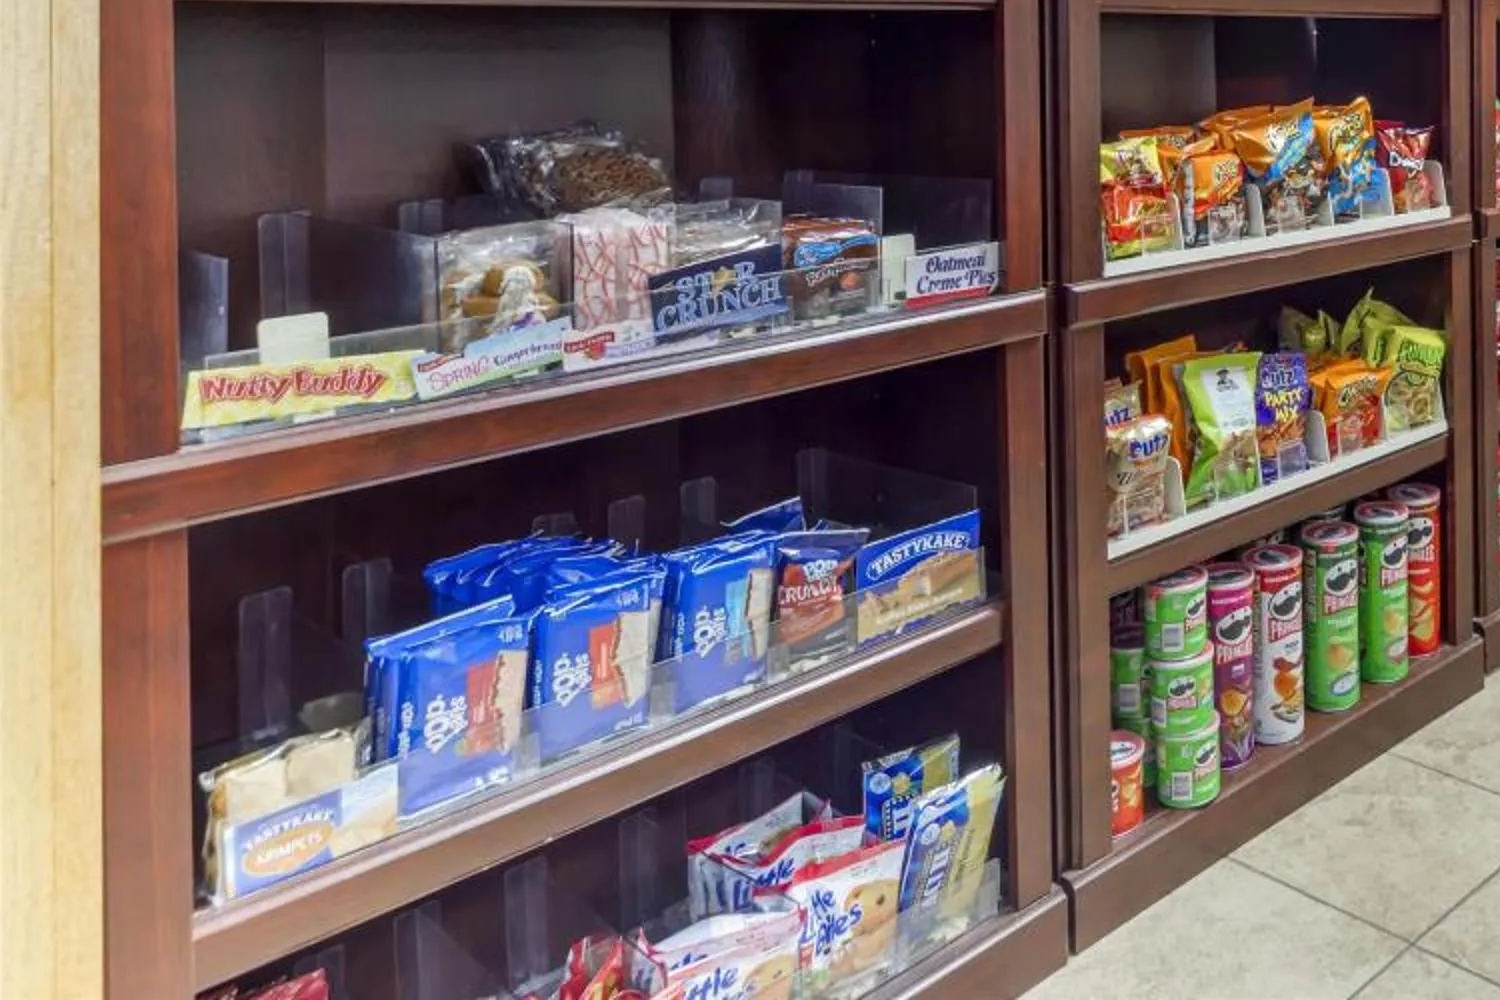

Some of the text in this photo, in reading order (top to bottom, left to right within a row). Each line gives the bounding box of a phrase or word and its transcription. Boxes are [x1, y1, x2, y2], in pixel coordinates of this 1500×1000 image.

[925, 250, 986, 274] Oatmeal
[916, 269, 995, 294] Creme Pies
[656, 275, 782, 331] CRUNCH
[199, 366, 387, 404] Nutty Buddy
[1263, 387, 1304, 406] PARTY
[1275, 406, 1299, 423] MIX
[869, 533, 970, 577] TASTYKAKE
[244, 807, 335, 852] TASTYKAKE
